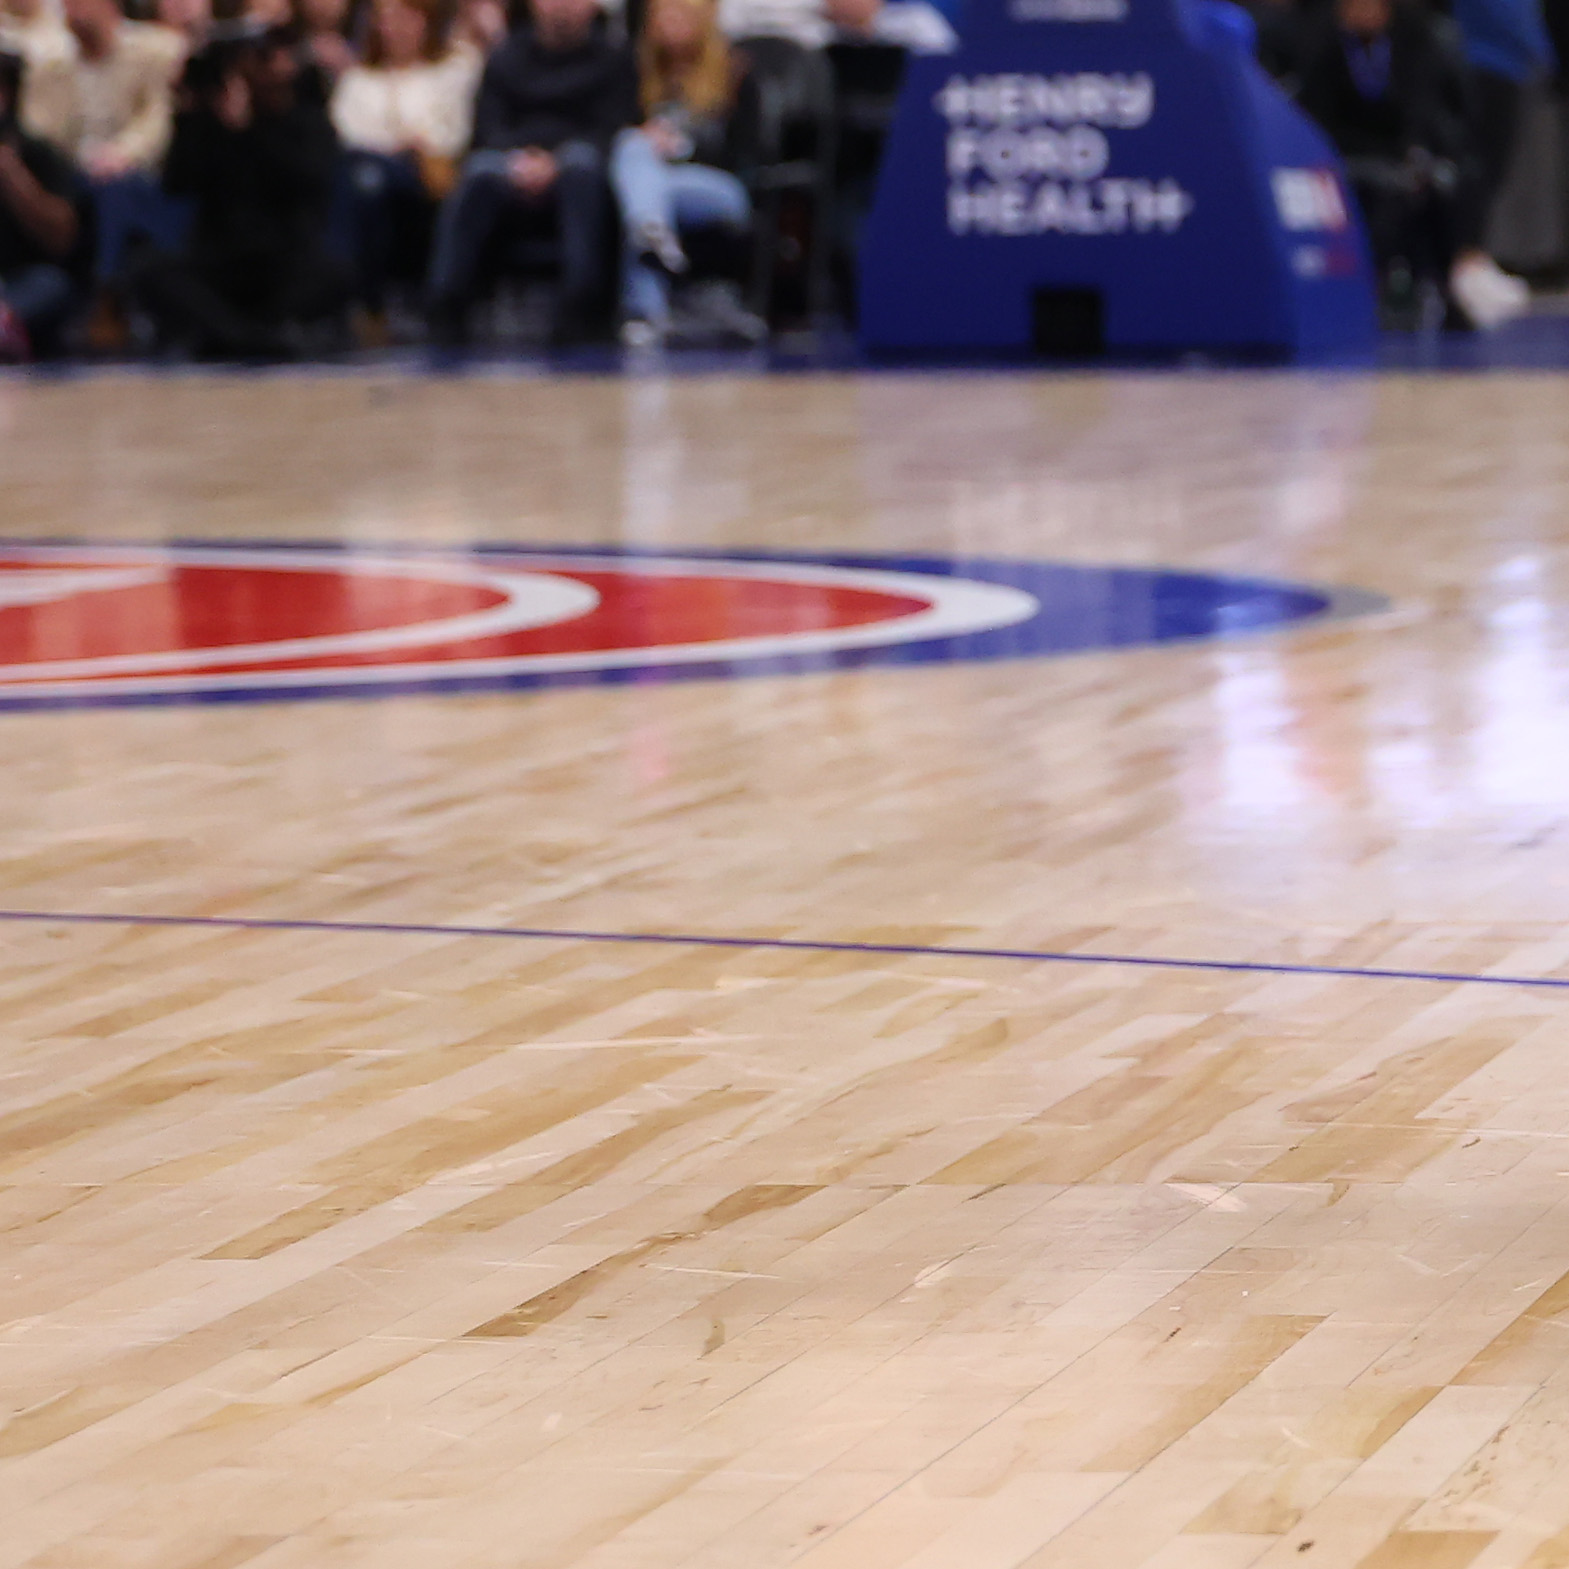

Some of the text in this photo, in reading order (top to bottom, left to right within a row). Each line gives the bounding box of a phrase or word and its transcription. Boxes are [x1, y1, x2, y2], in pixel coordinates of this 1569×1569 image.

[935, 73, 1154, 129] HENRY
[946, 126, 1110, 182] FORD
[946, 177, 1193, 234] HEALTH
